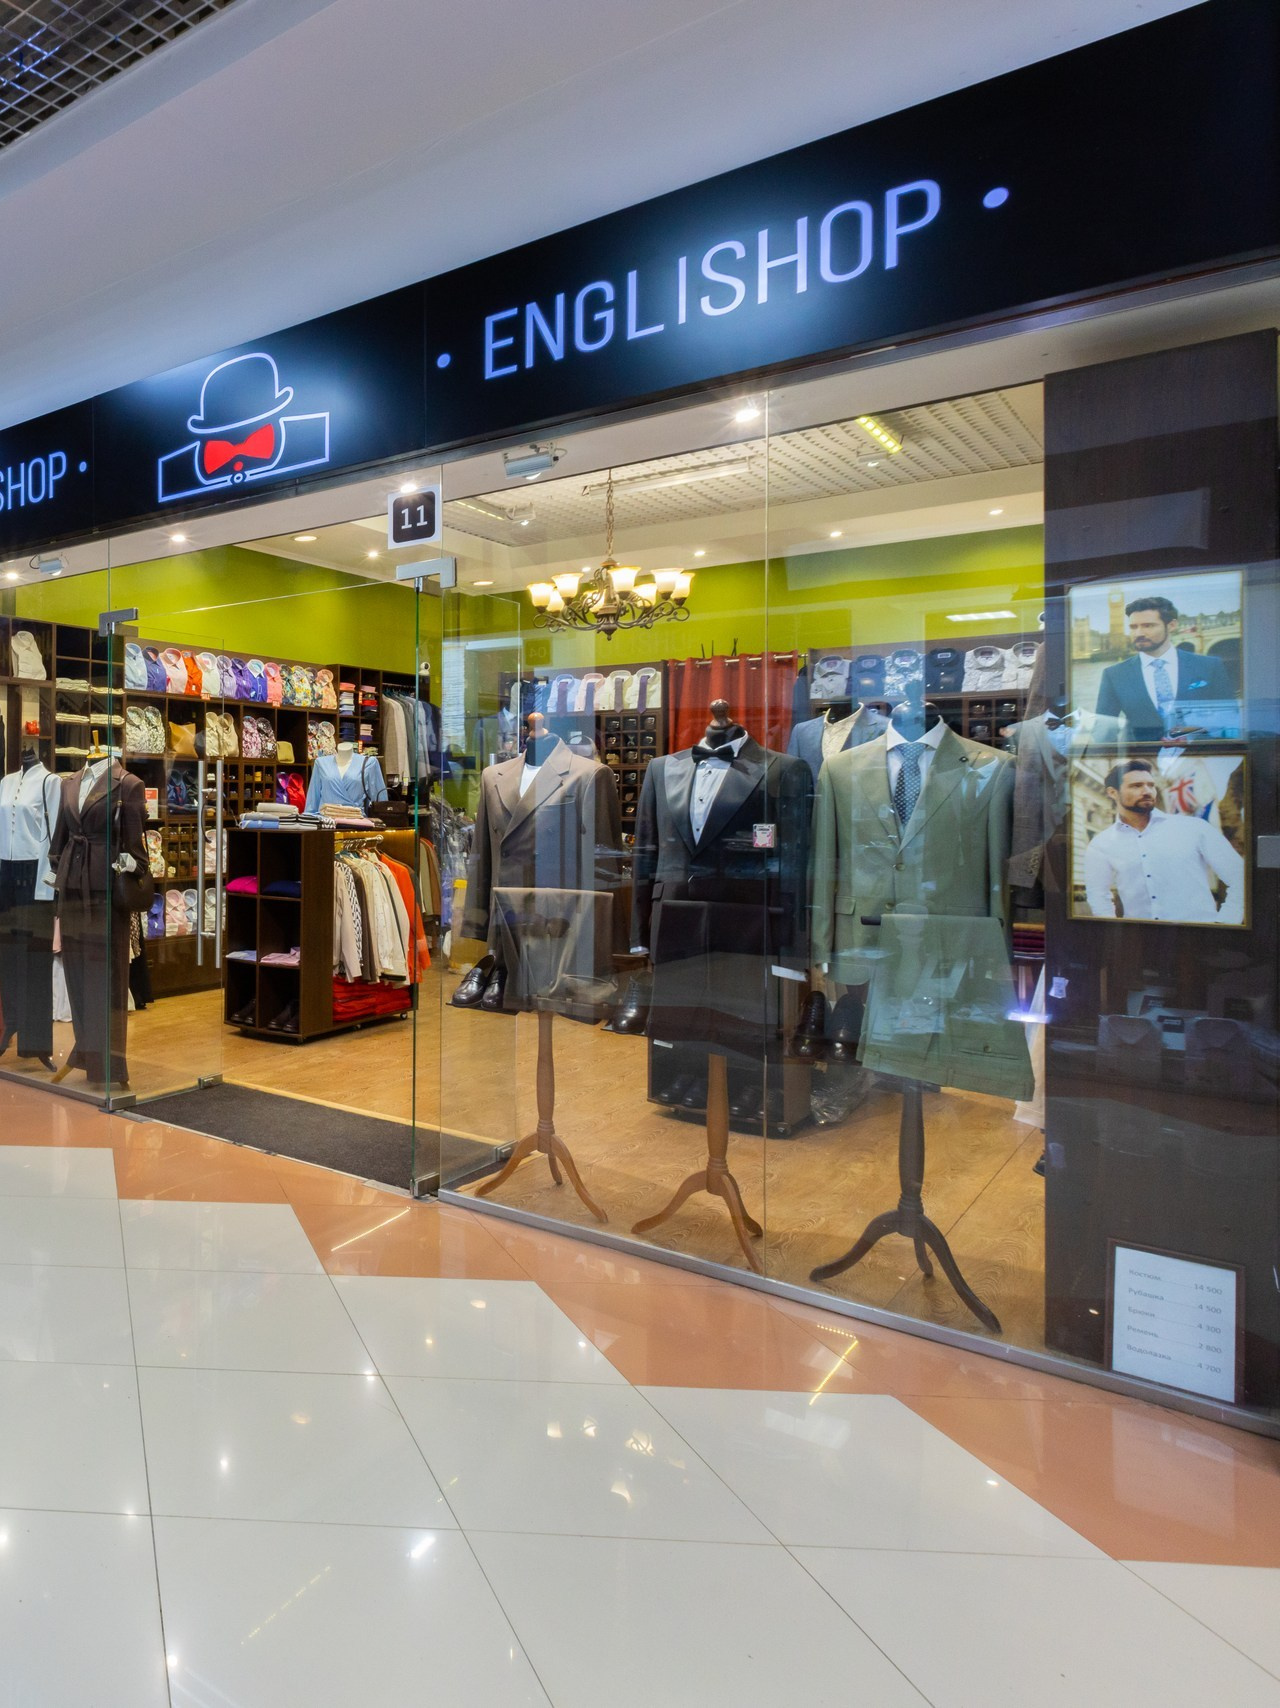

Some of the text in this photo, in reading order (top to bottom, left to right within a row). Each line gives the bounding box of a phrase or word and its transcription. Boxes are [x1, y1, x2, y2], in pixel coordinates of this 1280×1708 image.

[483, 178, 942, 381] ENGLISHOP
[399, 505, 429, 530] 11
[1128, 1287, 1164, 1301] Рубашка
[1206, 1305, 1222, 1314] 500
[1206, 1285, 1223, 1295] 500
[1127, 1324, 1159, 1338] Ремень
[1206, 1344, 1222, 1354] 800
[1126, 1343, 1172, 1360] Водолазка
[1206, 1364, 1222, 1374] 700
